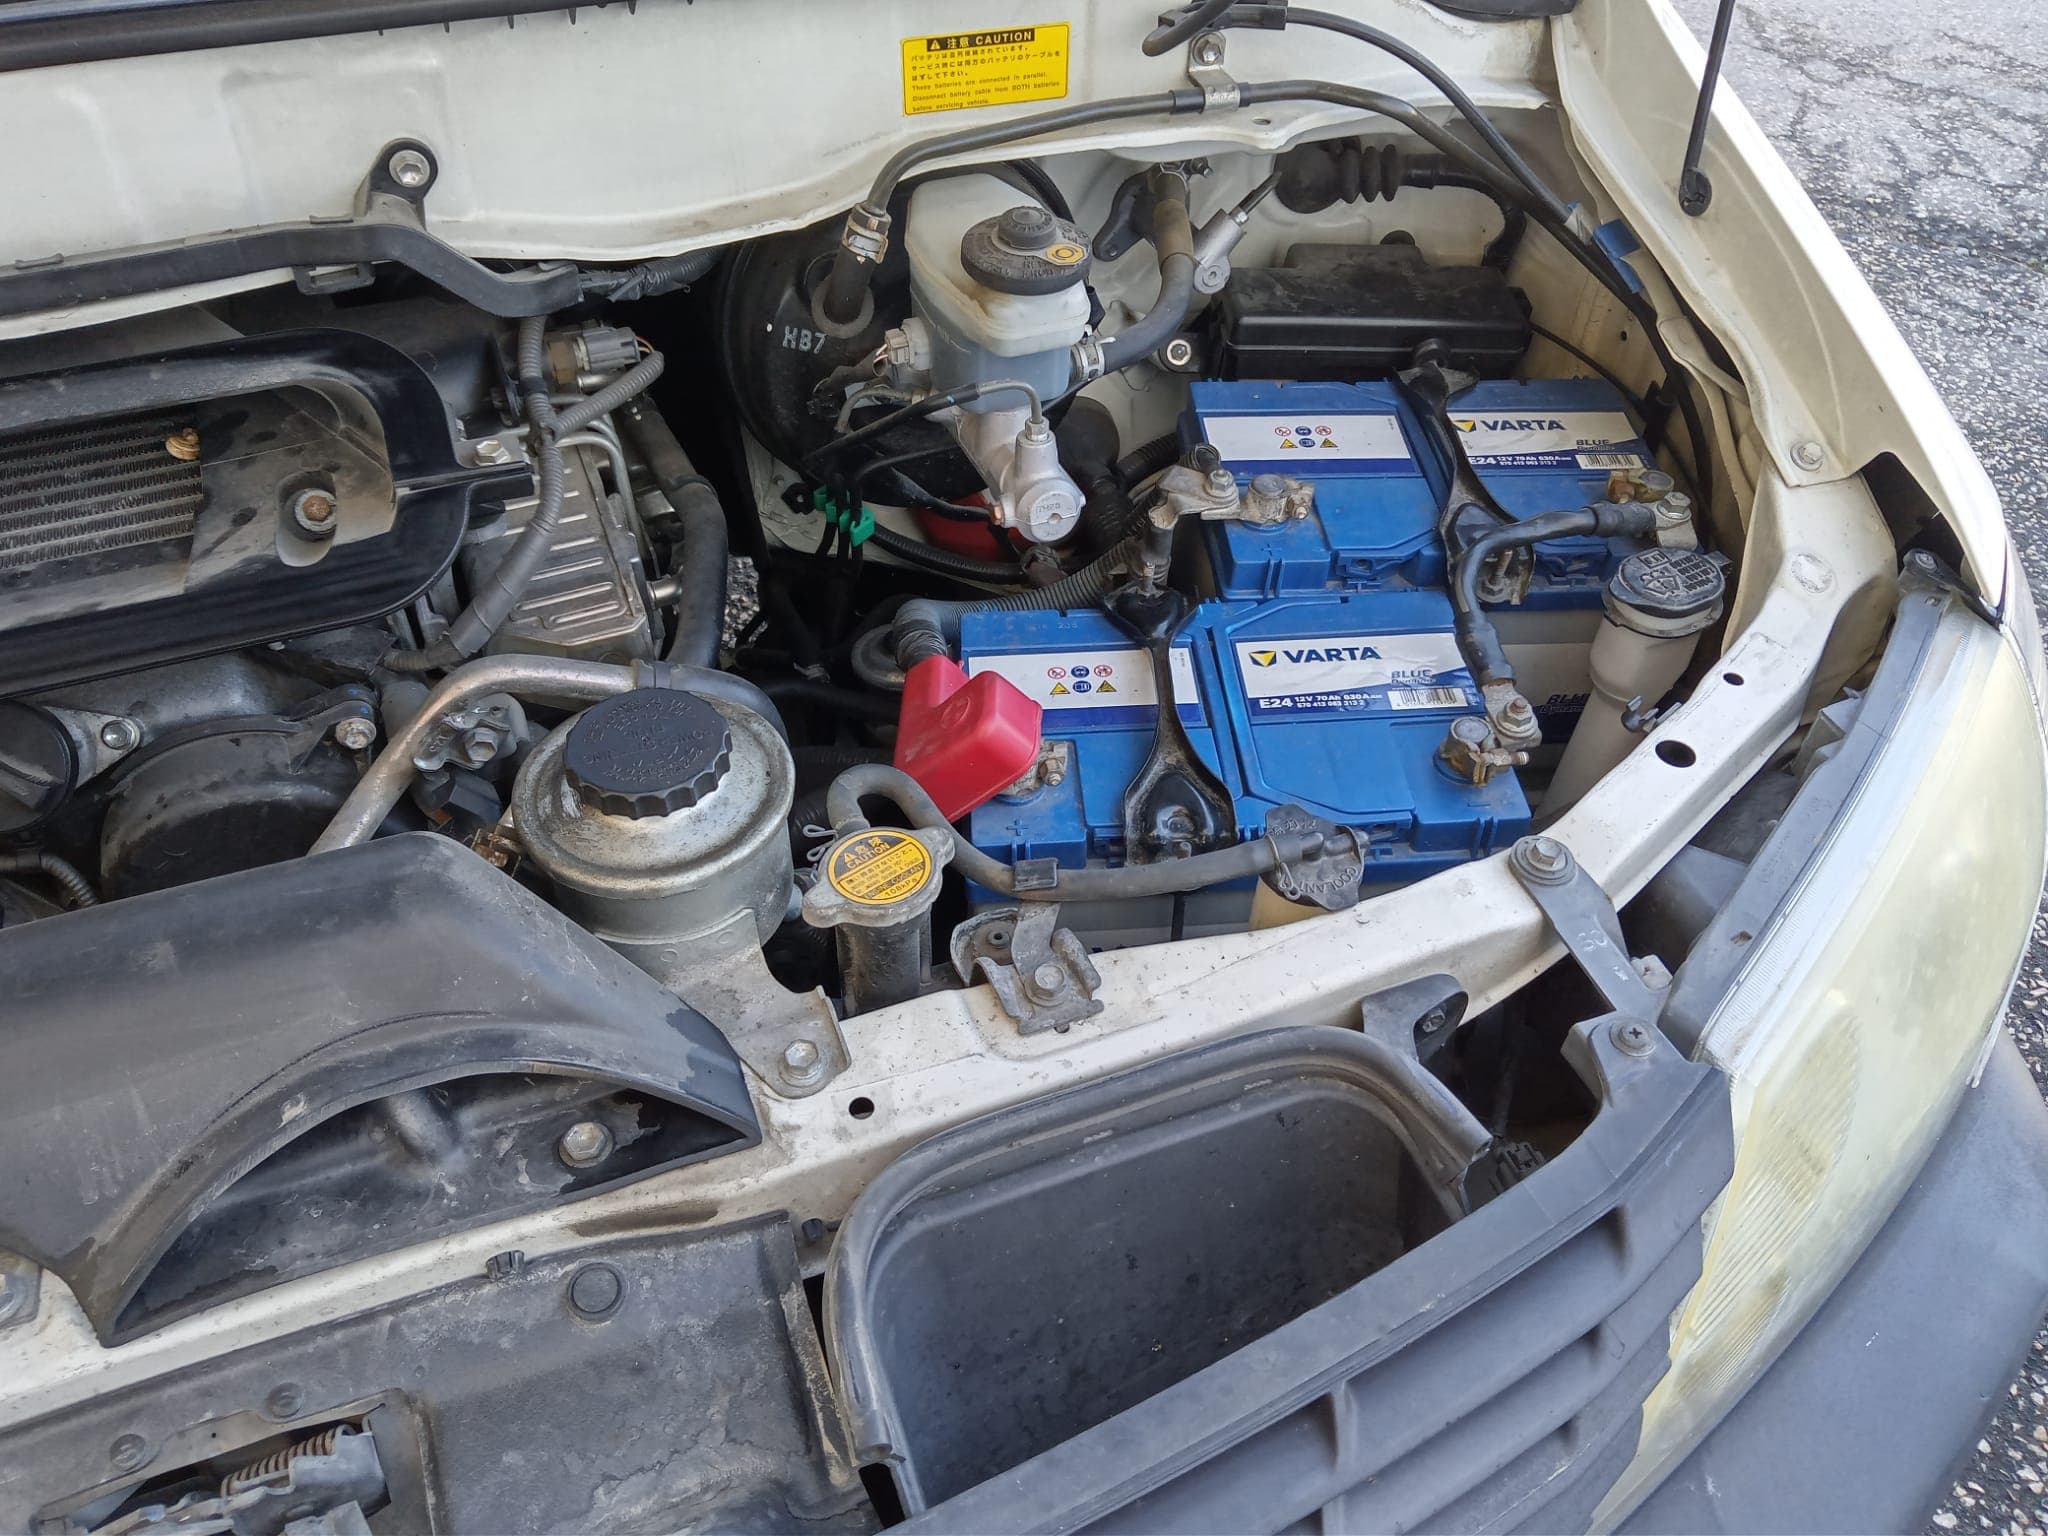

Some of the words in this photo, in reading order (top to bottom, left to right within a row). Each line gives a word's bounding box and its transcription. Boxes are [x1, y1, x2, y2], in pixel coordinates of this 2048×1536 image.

[947, 37, 969, 48] 注意
[976, 31, 1032, 45] CAUTION
[935, 81, 961, 89] batteries
[950, 90, 970, 98] battery
[975, 87, 991, 95] cable
[1480, 420, 1567, 431] VARTA
[1468, 457, 1496, 465] E24
[1283, 646, 1382, 664] VARTA
[1391, 669, 1433, 679] BLUE
[1259, 698, 1293, 709] E24
[847, 842, 890, 868] CAUTION
[888, 862, 926, 884] COOLANT
[1300, 866, 1359, 893] COOLANT
[885, 878, 917, 896] 108kPa
